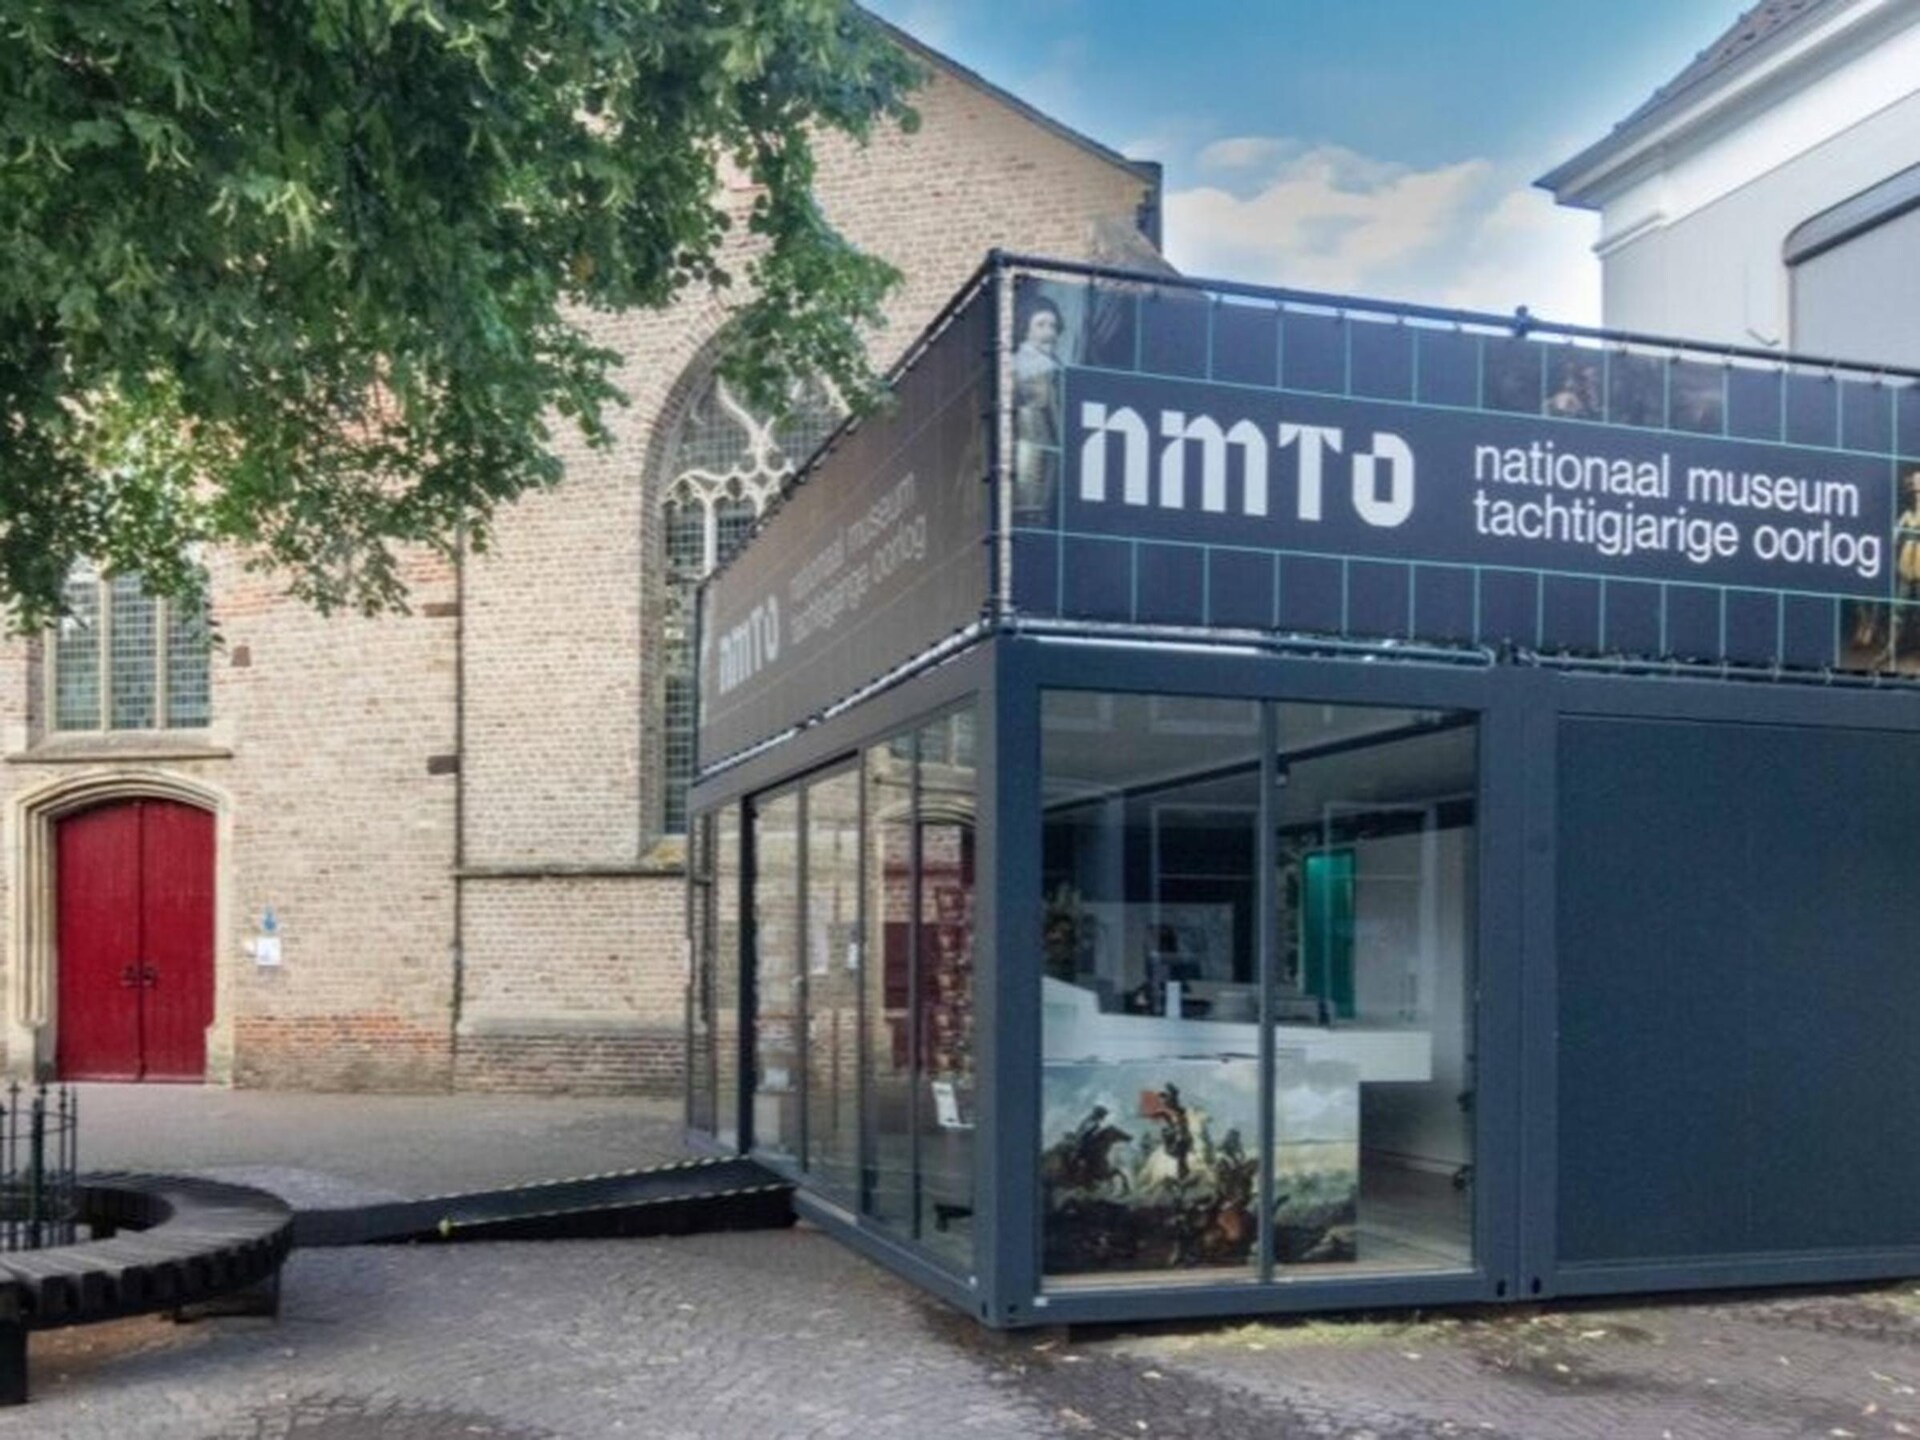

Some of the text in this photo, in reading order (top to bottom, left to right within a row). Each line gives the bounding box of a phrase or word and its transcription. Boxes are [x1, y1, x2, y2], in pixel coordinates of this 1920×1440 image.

[1474, 440, 1859, 517] nationaal museum
[1473, 489, 1881, 578] tachtigjarige oorlog
